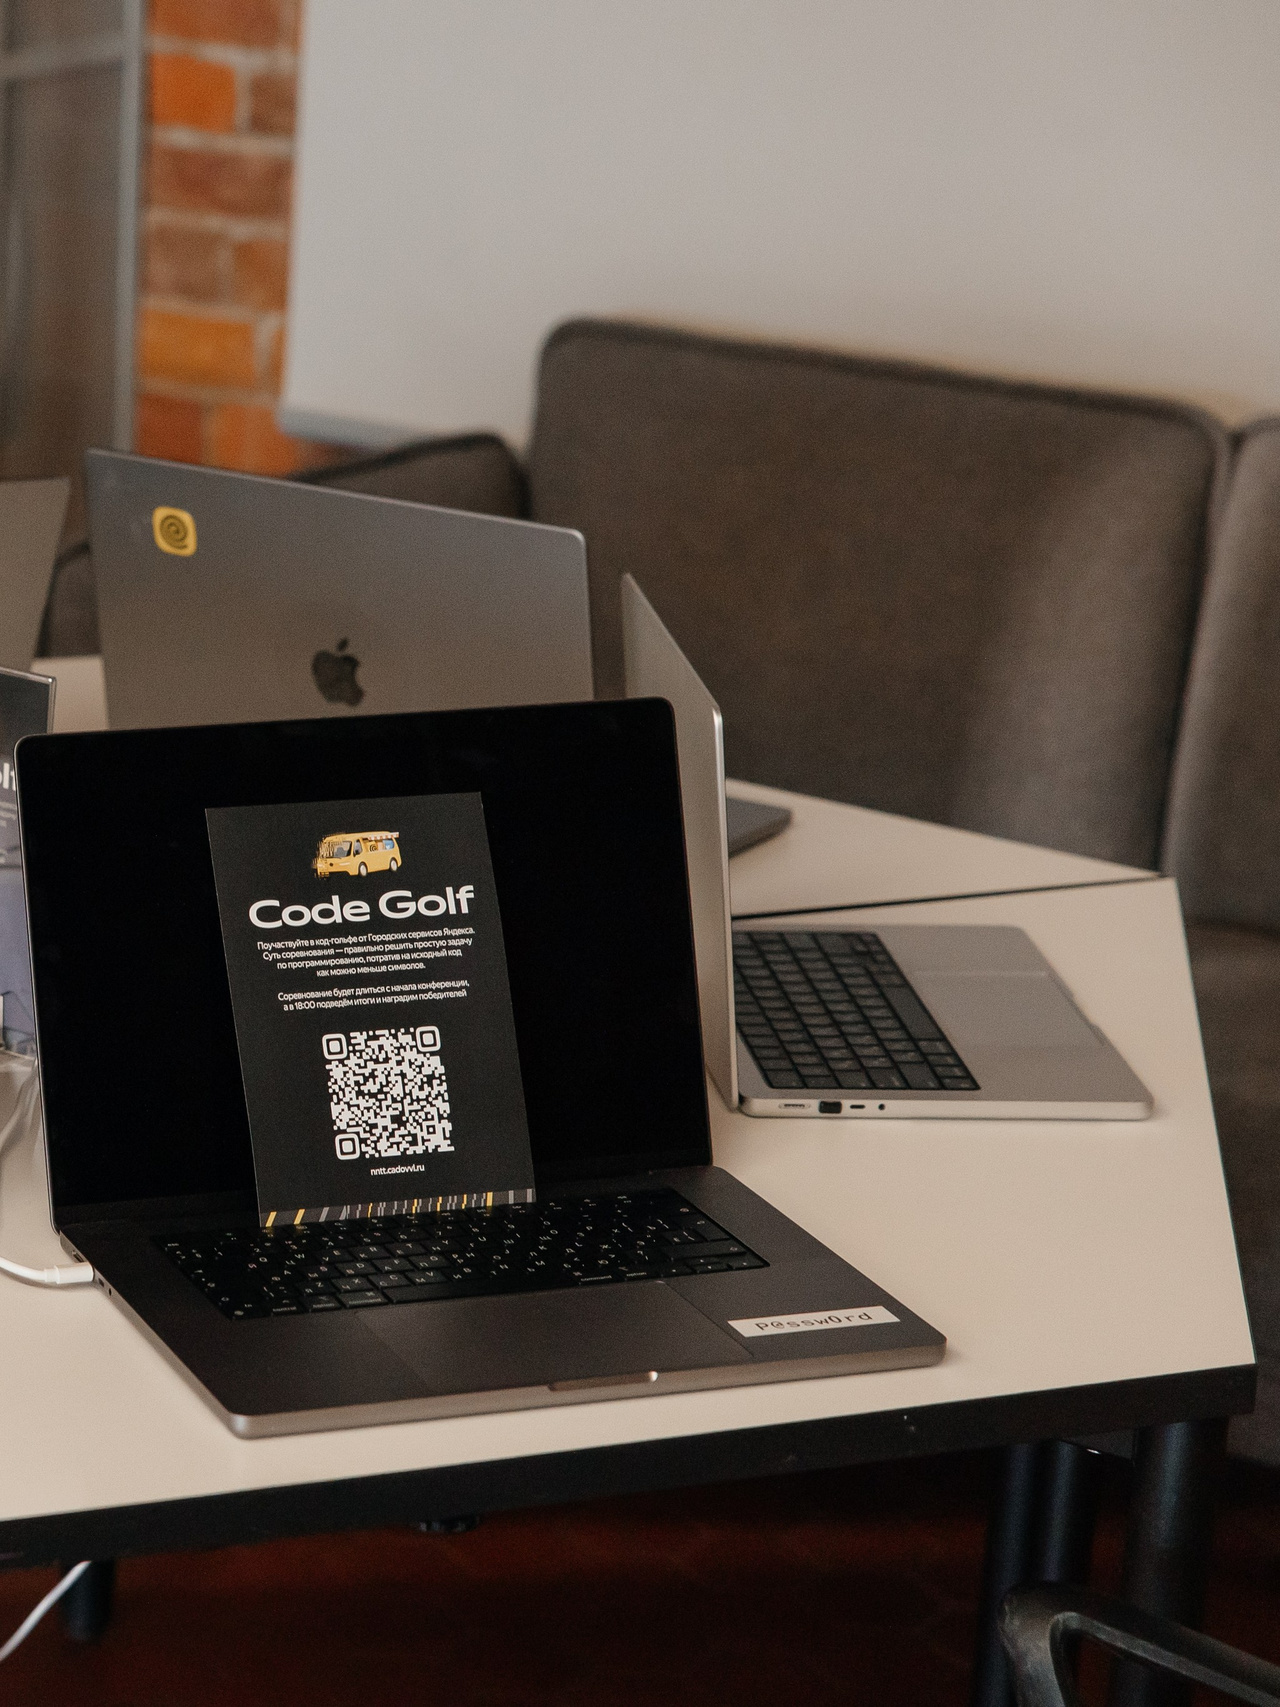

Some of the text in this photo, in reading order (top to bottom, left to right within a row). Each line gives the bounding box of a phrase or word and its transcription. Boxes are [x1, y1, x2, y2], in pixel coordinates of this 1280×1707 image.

[249, 885, 475, 929] Code Golf
[257, 939, 309, 951] Поучаствуйте
[315, 935, 358, 946] код-гольфе
[368, 933, 408, 942] Городских
[408, 930, 443, 939] сервисов
[443, 927, 475, 936] Яндекса.
[263, 951, 281, 961] Суть
[282, 948, 335, 959] соревнования
[344, 945, 384, 955] правильно
[385, 943, 413, 952] решить
[414, 940, 447, 949] простую
[447, 938, 472, 946] задачу
[288, 957, 366, 969] программированию,
[366, 954, 401, 963] потратив
[411, 949, 447, 959] исходный
[448, 949, 462, 957] код
[330, 968, 356, 976] можно
[357, 965, 387, 974] меньше
[388, 962, 426, 971] символов.
[278, 990, 332, 1001] Соревнование
[333, 988, 354, 998] будет
[355, 986, 385, 996] длиться
[391, 984, 417, 992] начала
[417, 980, 470, 990] конференции,
[295, 1001, 316, 1010] 18:00
[382, 994, 418, 1004] наградим
[419, 989, 467, 1000] победителей
[755, 1312, 873, 1331] P@ssw0rd
